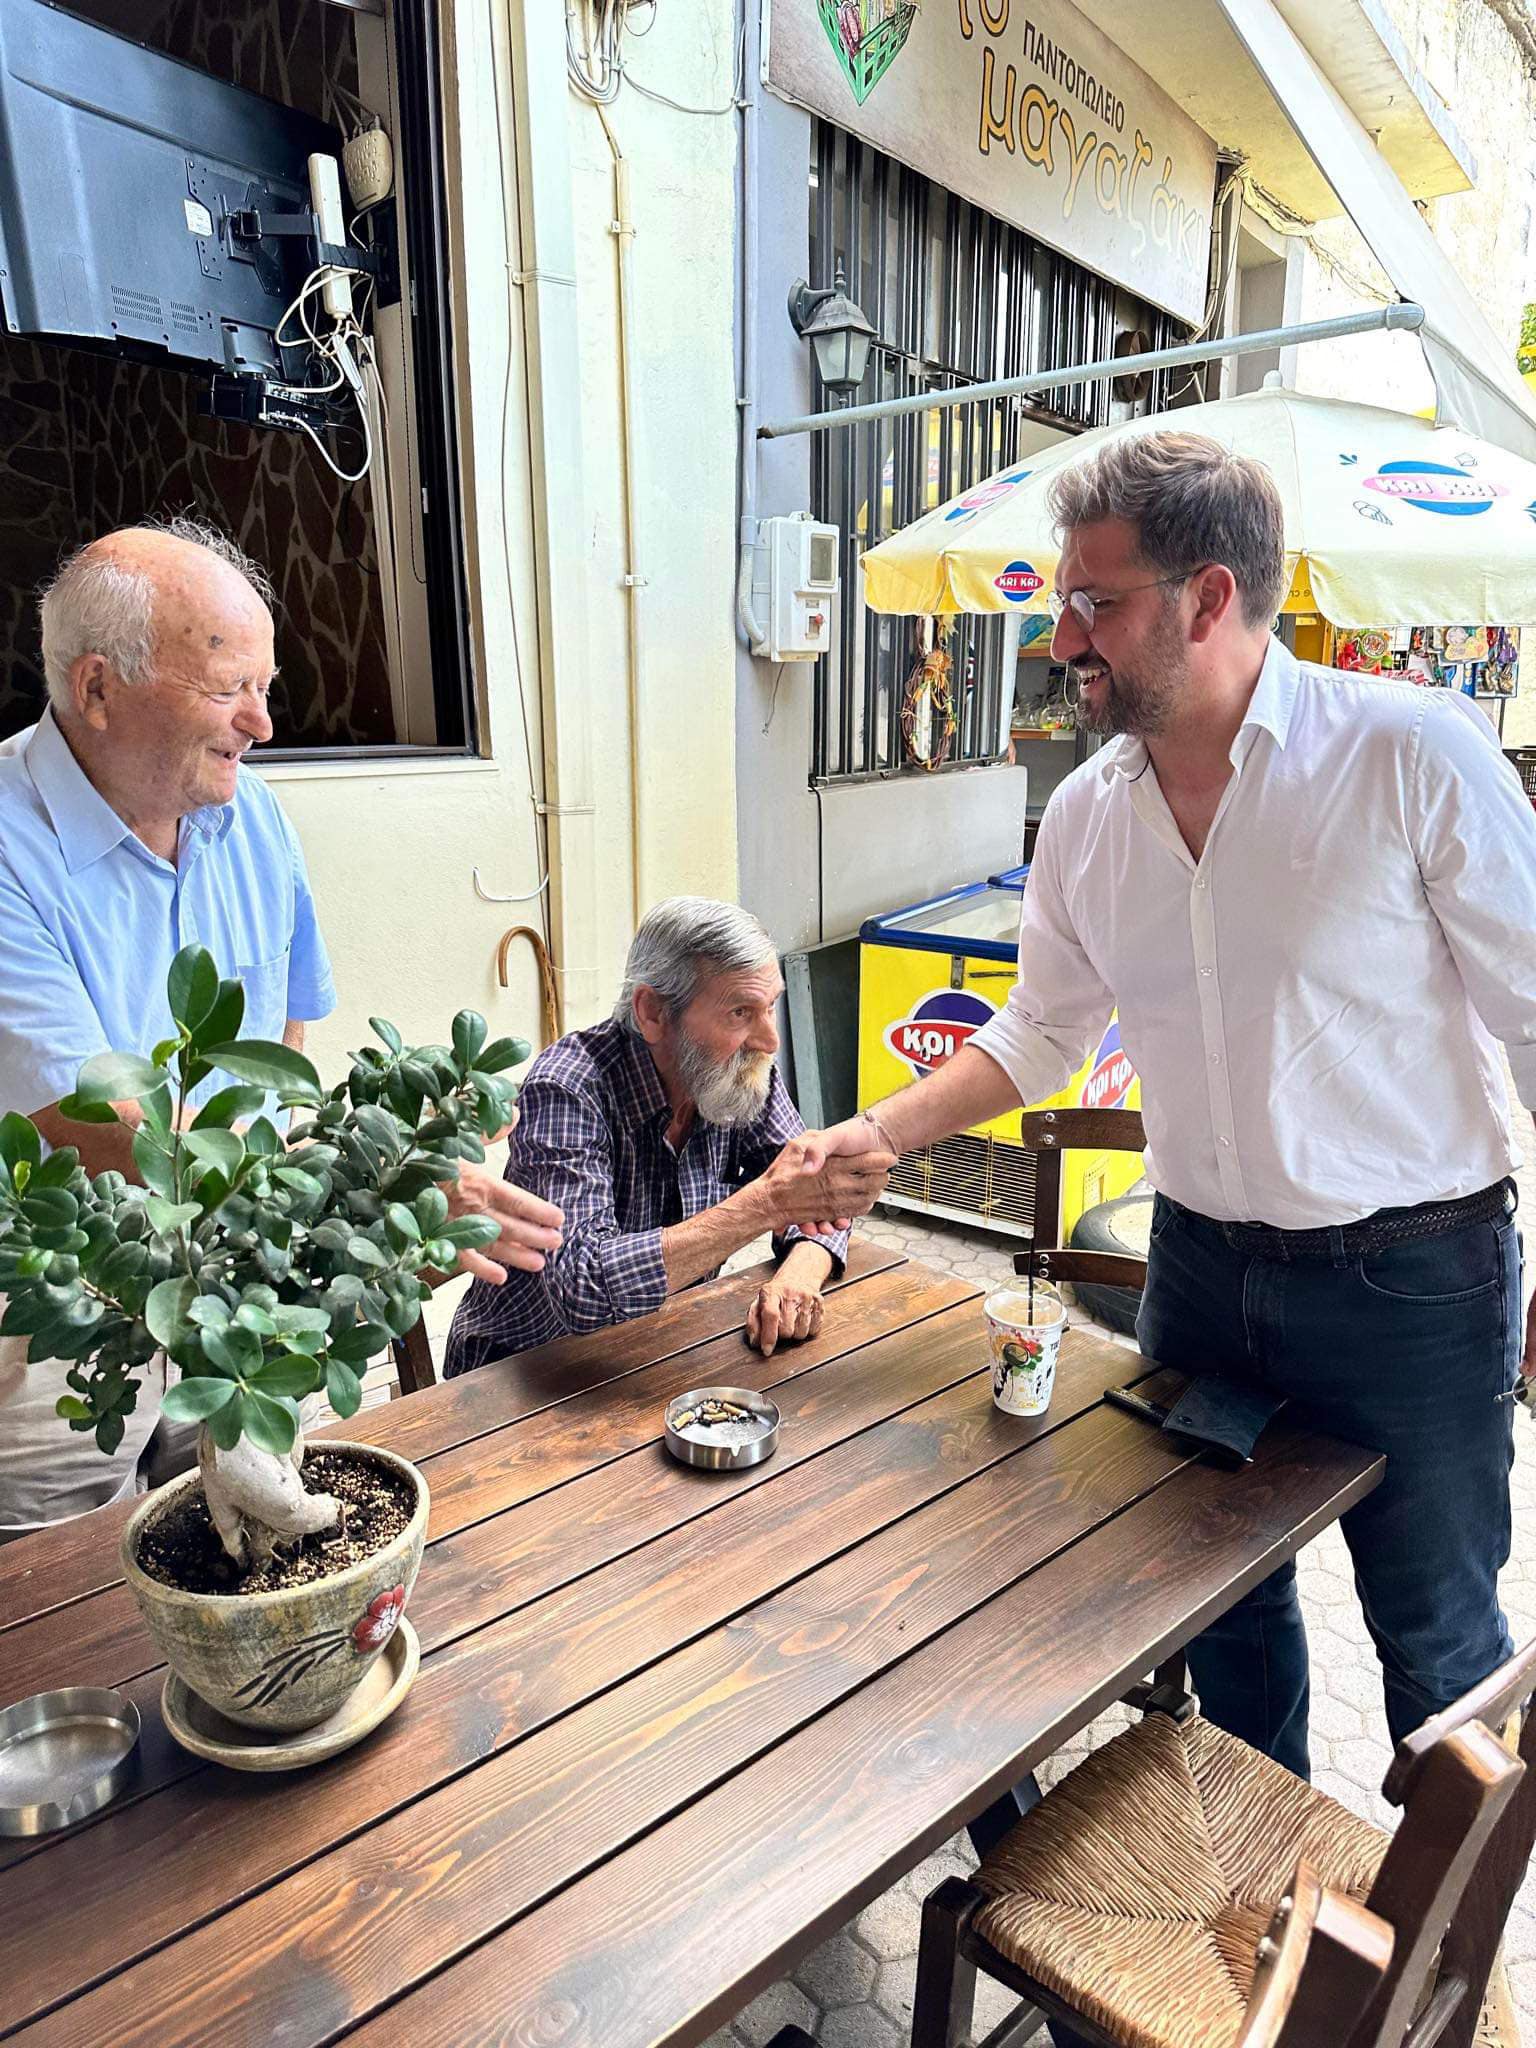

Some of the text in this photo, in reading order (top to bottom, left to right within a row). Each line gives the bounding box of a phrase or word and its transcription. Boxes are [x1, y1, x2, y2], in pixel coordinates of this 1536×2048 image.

[1023, 19, 1125, 133] ΠΑΝΤΟΠΩΛΕΙΟ
[979, 47, 1204, 275] μαγαζάκι
[999, 577, 1038, 587] KRI KRI
